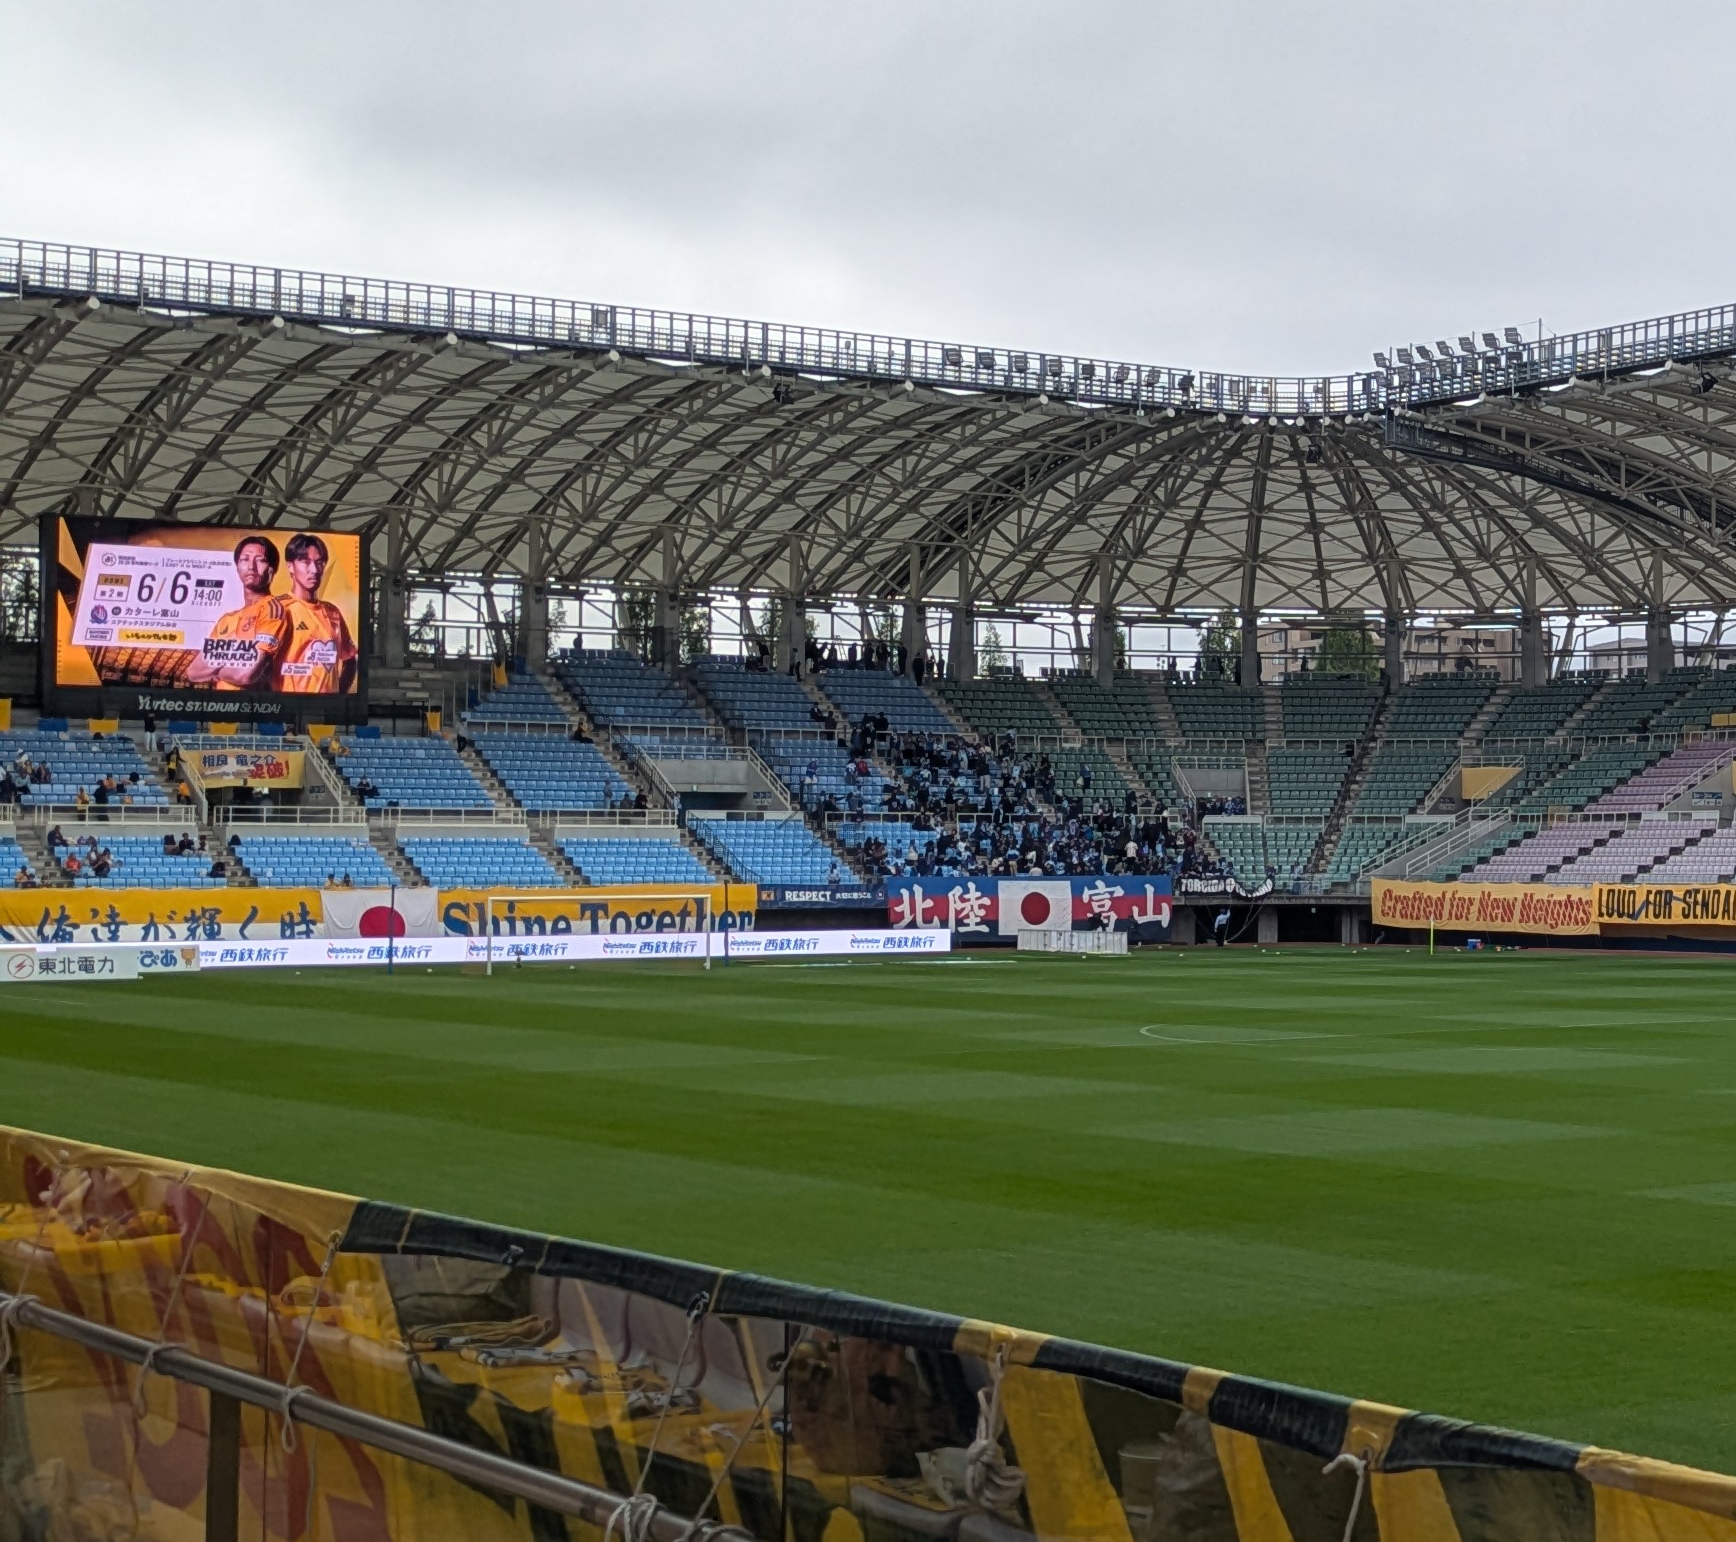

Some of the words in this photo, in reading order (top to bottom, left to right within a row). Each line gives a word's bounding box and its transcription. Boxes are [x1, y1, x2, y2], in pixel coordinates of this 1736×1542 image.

[193, 589, 222, 602] 14:00
[124, 607, 180, 618] カターレ富山
[186, 701, 240, 713] STADIUM
[785, 890, 832, 902] RESPECT
[893, 882, 992, 934] 北陸
[1082, 880, 1172, 932] 富山
[1380, 888, 1448, 920] Crafted
[1448, 890, 1476, 922] for
[1476, 890, 1518, 923] New
[1597, 888, 1637, 919] LOUD
[1645, 889, 1674, 919] FOR
[0, 901, 318, 943] 俺達が輝く時
[443, 901, 572, 937] Shine
[578, 897, 753, 935] Together
[507, 943, 569, 956] 西鉄旅行
[639, 941, 698, 954] 西鉄旅行
[764, 938, 819, 951] 西鉄旅行
[883, 936, 936, 949] 西鉄旅行
[139, 949, 178, 968] ぴあ
[220, 947, 290, 963] 西鉄旅行
[367, 945, 433, 959] 西鉄旅行
[38, 956, 115, 975] 東北電力
